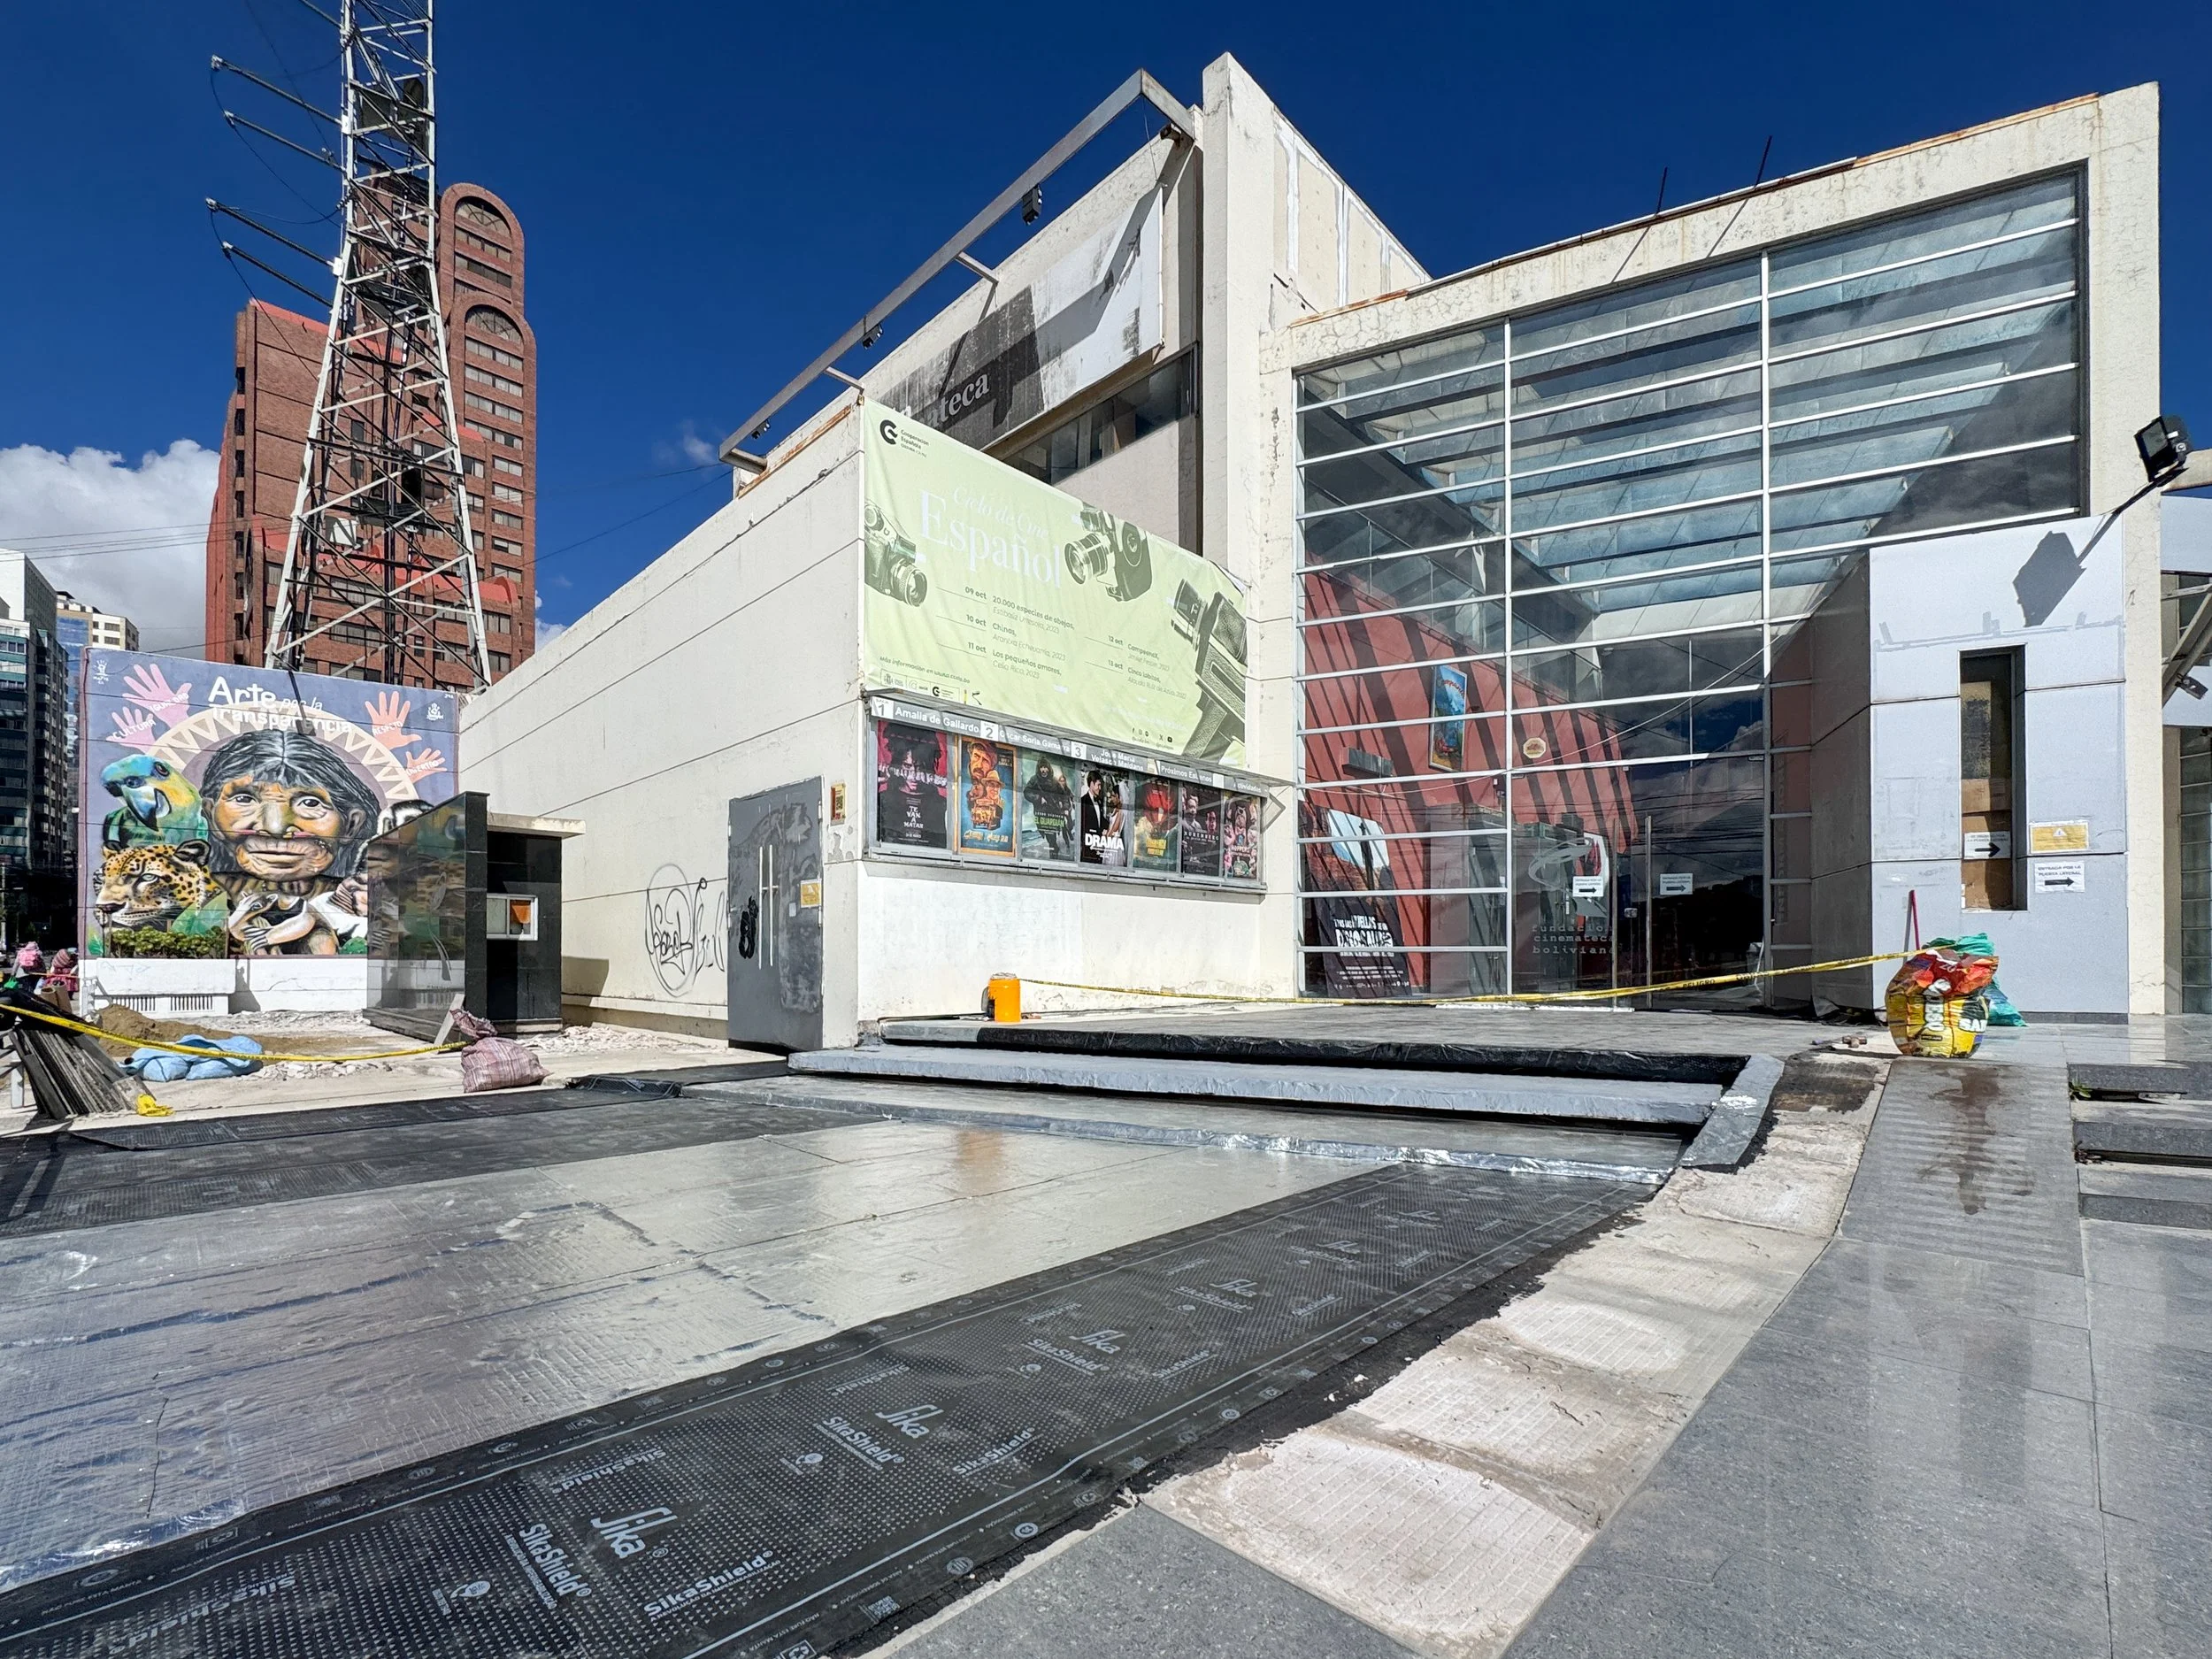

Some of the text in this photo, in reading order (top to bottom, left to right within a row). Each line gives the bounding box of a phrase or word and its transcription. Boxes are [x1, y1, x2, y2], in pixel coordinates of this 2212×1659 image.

[953, 487, 992, 516] Ciclo
[995, 507, 1012, 525] de
[921, 491, 1061, 590] Español
[964, 586, 987, 600] 09 oct
[993, 595, 1016, 610] 20.000
[1017, 604, 1043, 620] especies
[966, 614, 987, 627] 10 oct
[992, 622, 1017, 636] Chinas,
[968, 641, 987, 654] 11 oct
[992, 649, 1004, 658] Los
[1005, 653, 1036, 669] pequeños
[208, 676, 277, 709] Arte
[311, 697, 323, 711] la
[208, 703, 352, 733] Transparencia
[878, 703, 885, 717] 1
[112, 718, 157, 739] CULTURA
[929, 712, 941, 725] de
[942, 717, 979, 733] Gallardo
[986, 727, 994, 739] 2
[1022, 734, 1041, 747] Soria
[1074, 747, 1082, 757] 3
[1161, 765, 1187, 778] Próximos
[1085, 833, 1125, 851] DRAMA
[1682, 979, 1716, 989] PELIGRO
[1069, 1330, 1125, 1354] Sika
[875, 1404, 944, 1439] Sika
[590, 1507, 678, 1559] Sika
